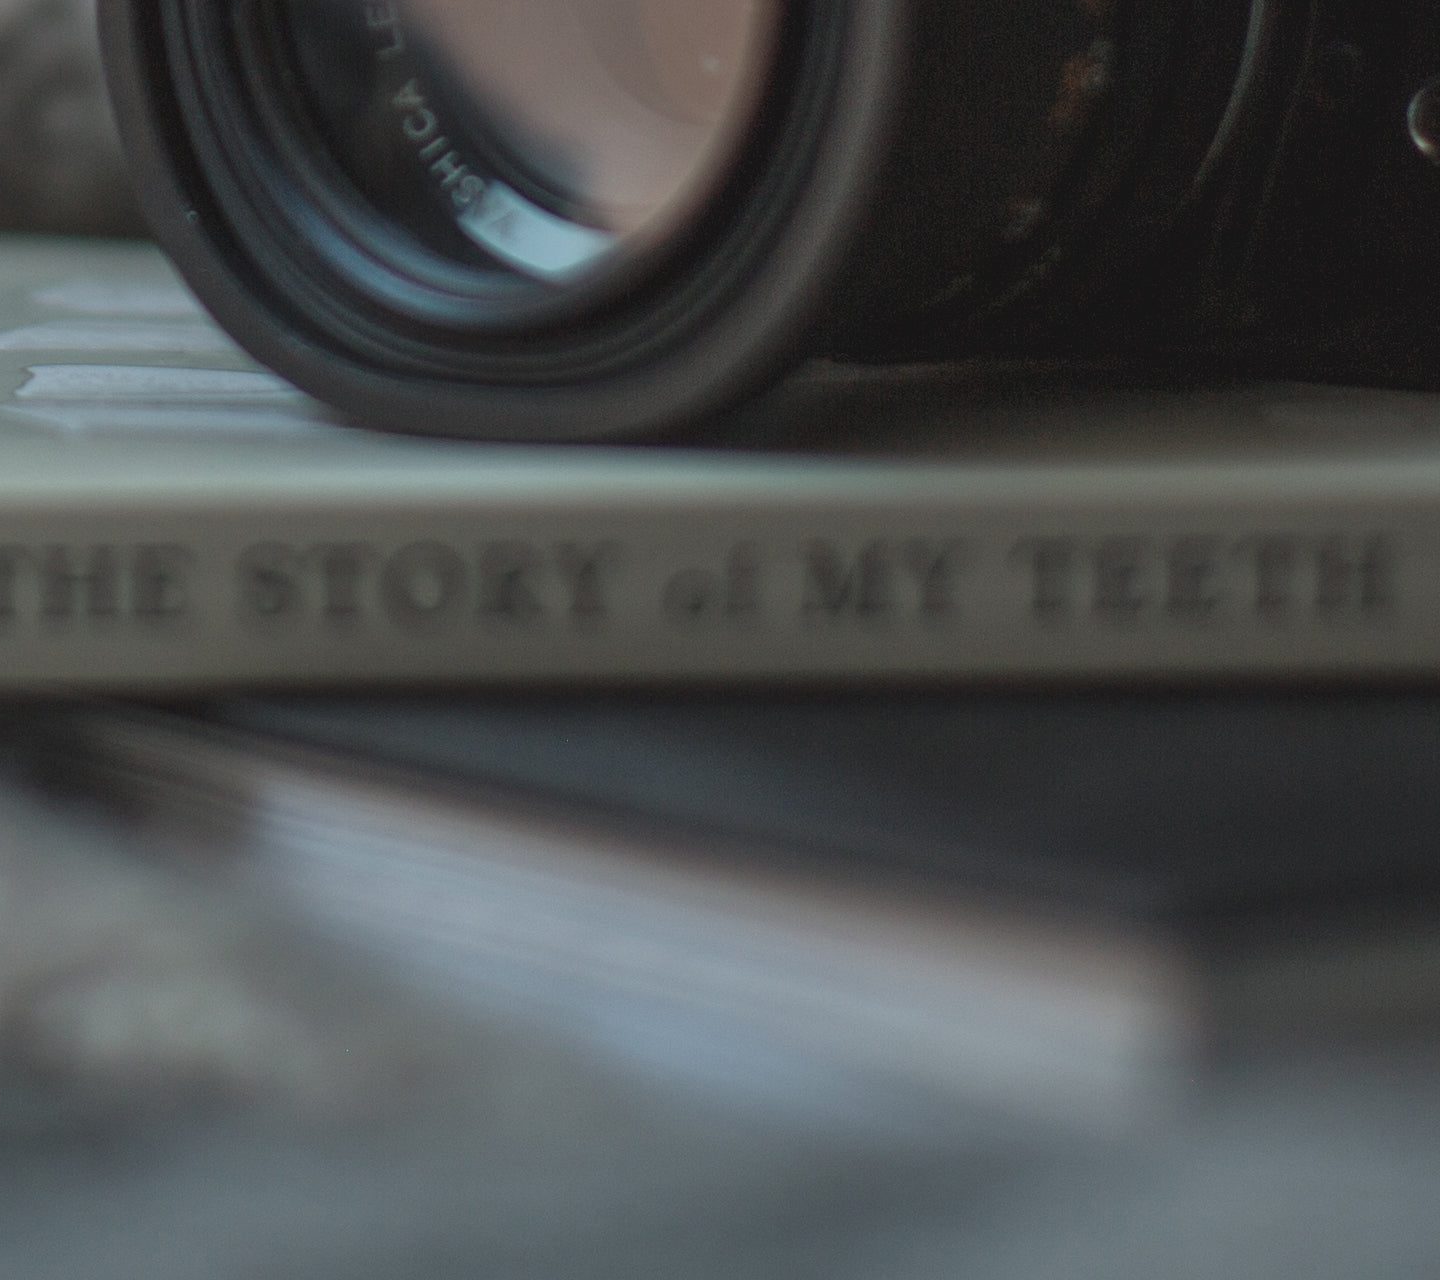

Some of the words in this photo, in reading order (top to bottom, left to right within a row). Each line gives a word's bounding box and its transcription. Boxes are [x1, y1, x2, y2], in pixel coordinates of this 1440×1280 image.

[235, 539, 620, 630] STORY
[658, 539, 765, 627] of
[800, 536, 970, 626] MY
[1012, 532, 1403, 623] TEETH
